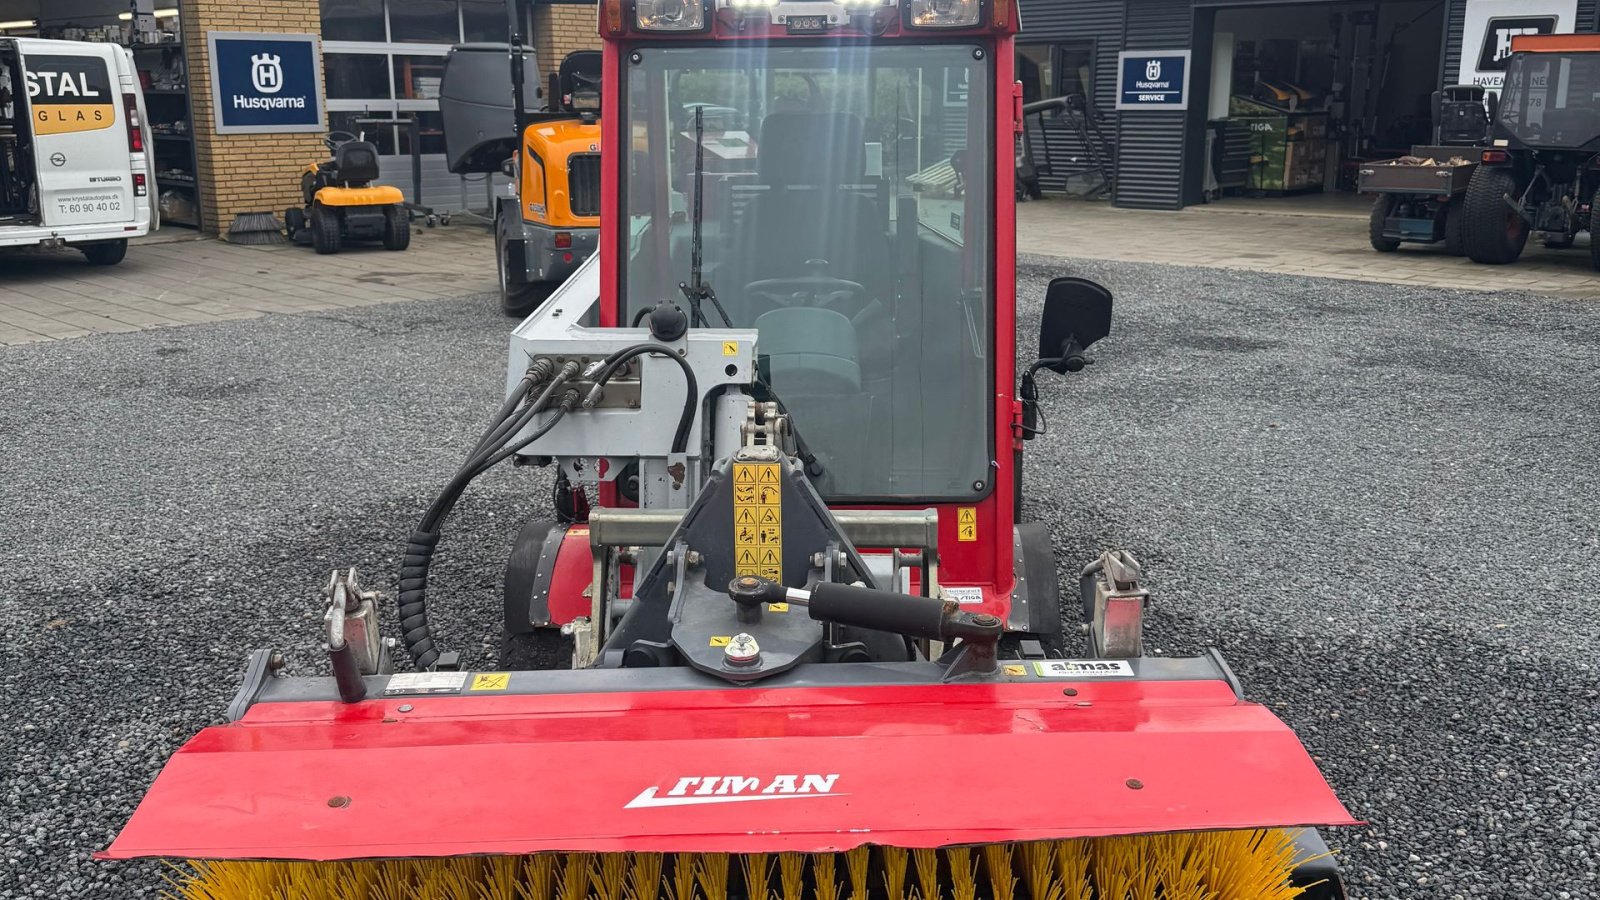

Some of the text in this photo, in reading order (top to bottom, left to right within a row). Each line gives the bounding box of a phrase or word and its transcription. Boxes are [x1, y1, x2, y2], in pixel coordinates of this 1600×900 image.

[25, 71, 99, 97] STAL
[1135, 81, 1169, 89] Husqvarna
[233, 95, 305, 110] Husqvarna
[38, 110, 102, 121] GLAS
[1250, 123, 1273, 131] TIGA
[58, 202, 120, 213] T: 60 90 40 02
